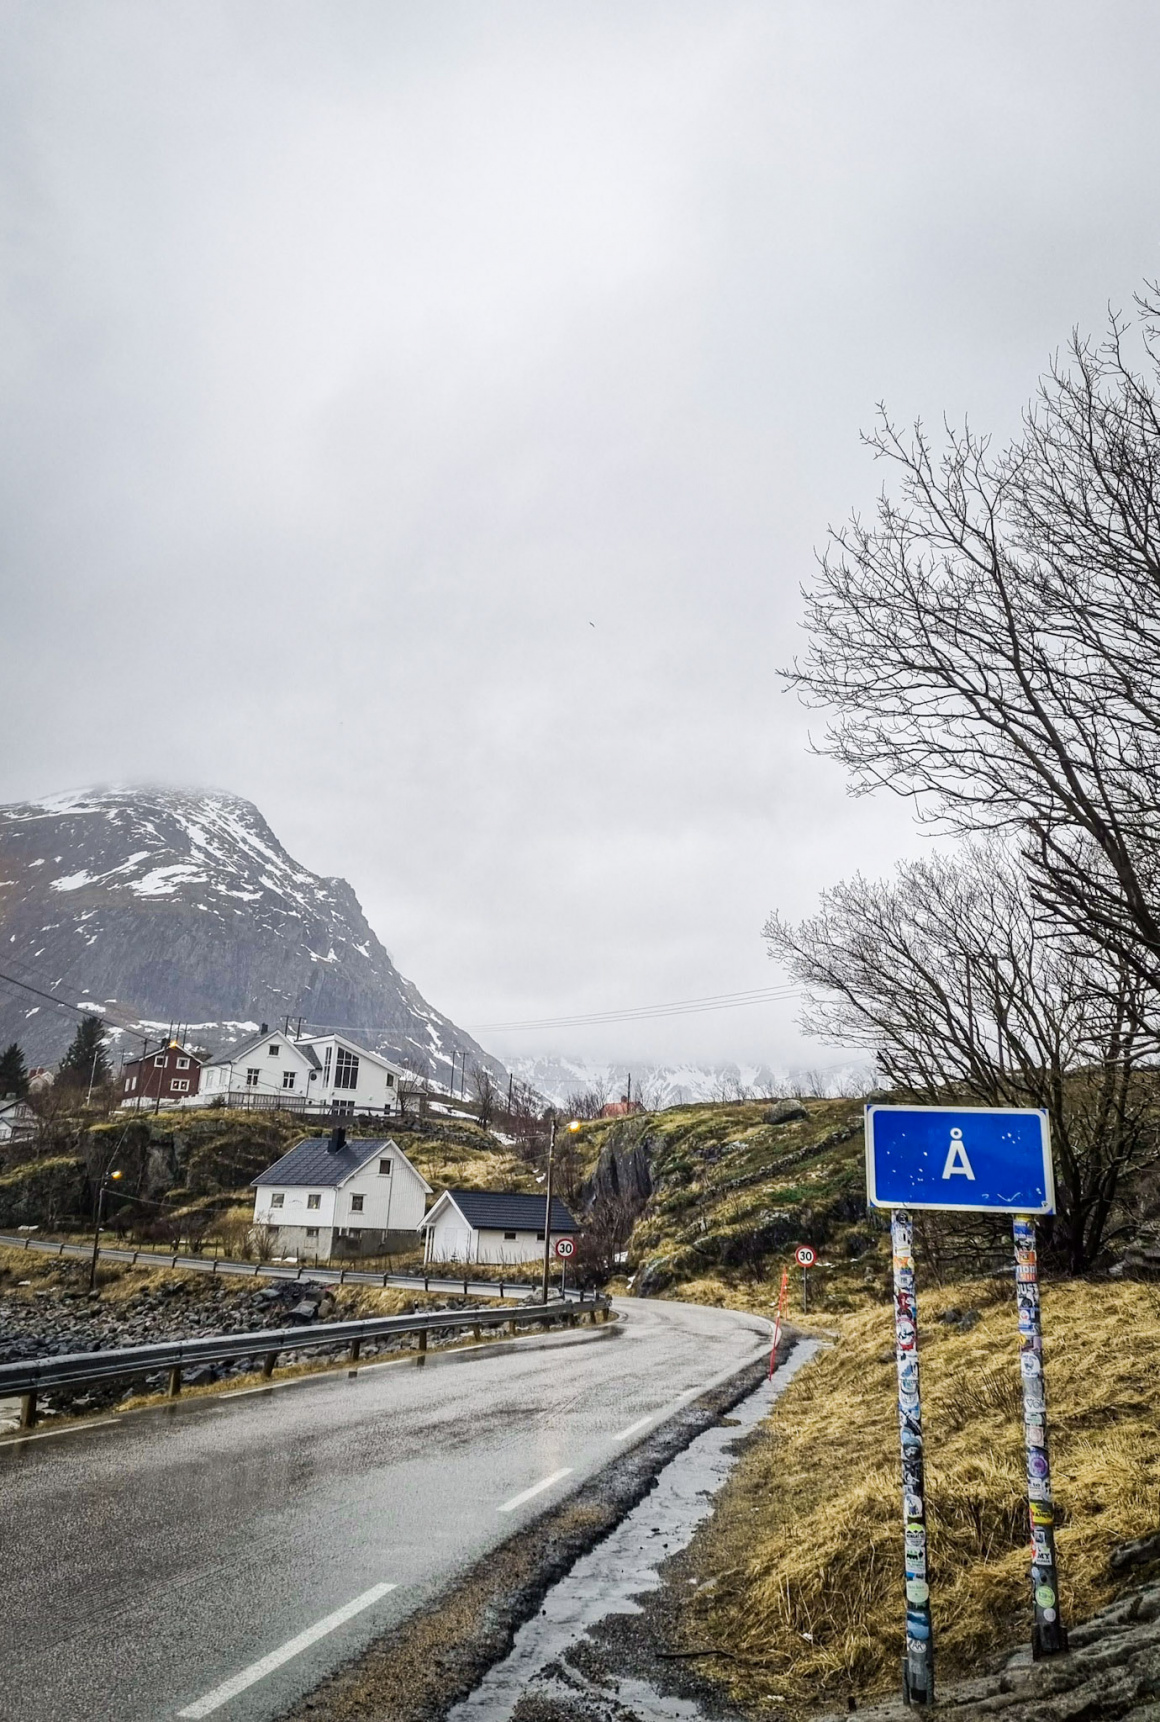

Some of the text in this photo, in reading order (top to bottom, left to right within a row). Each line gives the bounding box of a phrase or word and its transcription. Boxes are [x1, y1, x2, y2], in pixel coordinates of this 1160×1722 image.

[942, 1127, 976, 1181] Å
[560, 1244, 572, 1254] 30
[800, 1252, 812, 1261] 30
